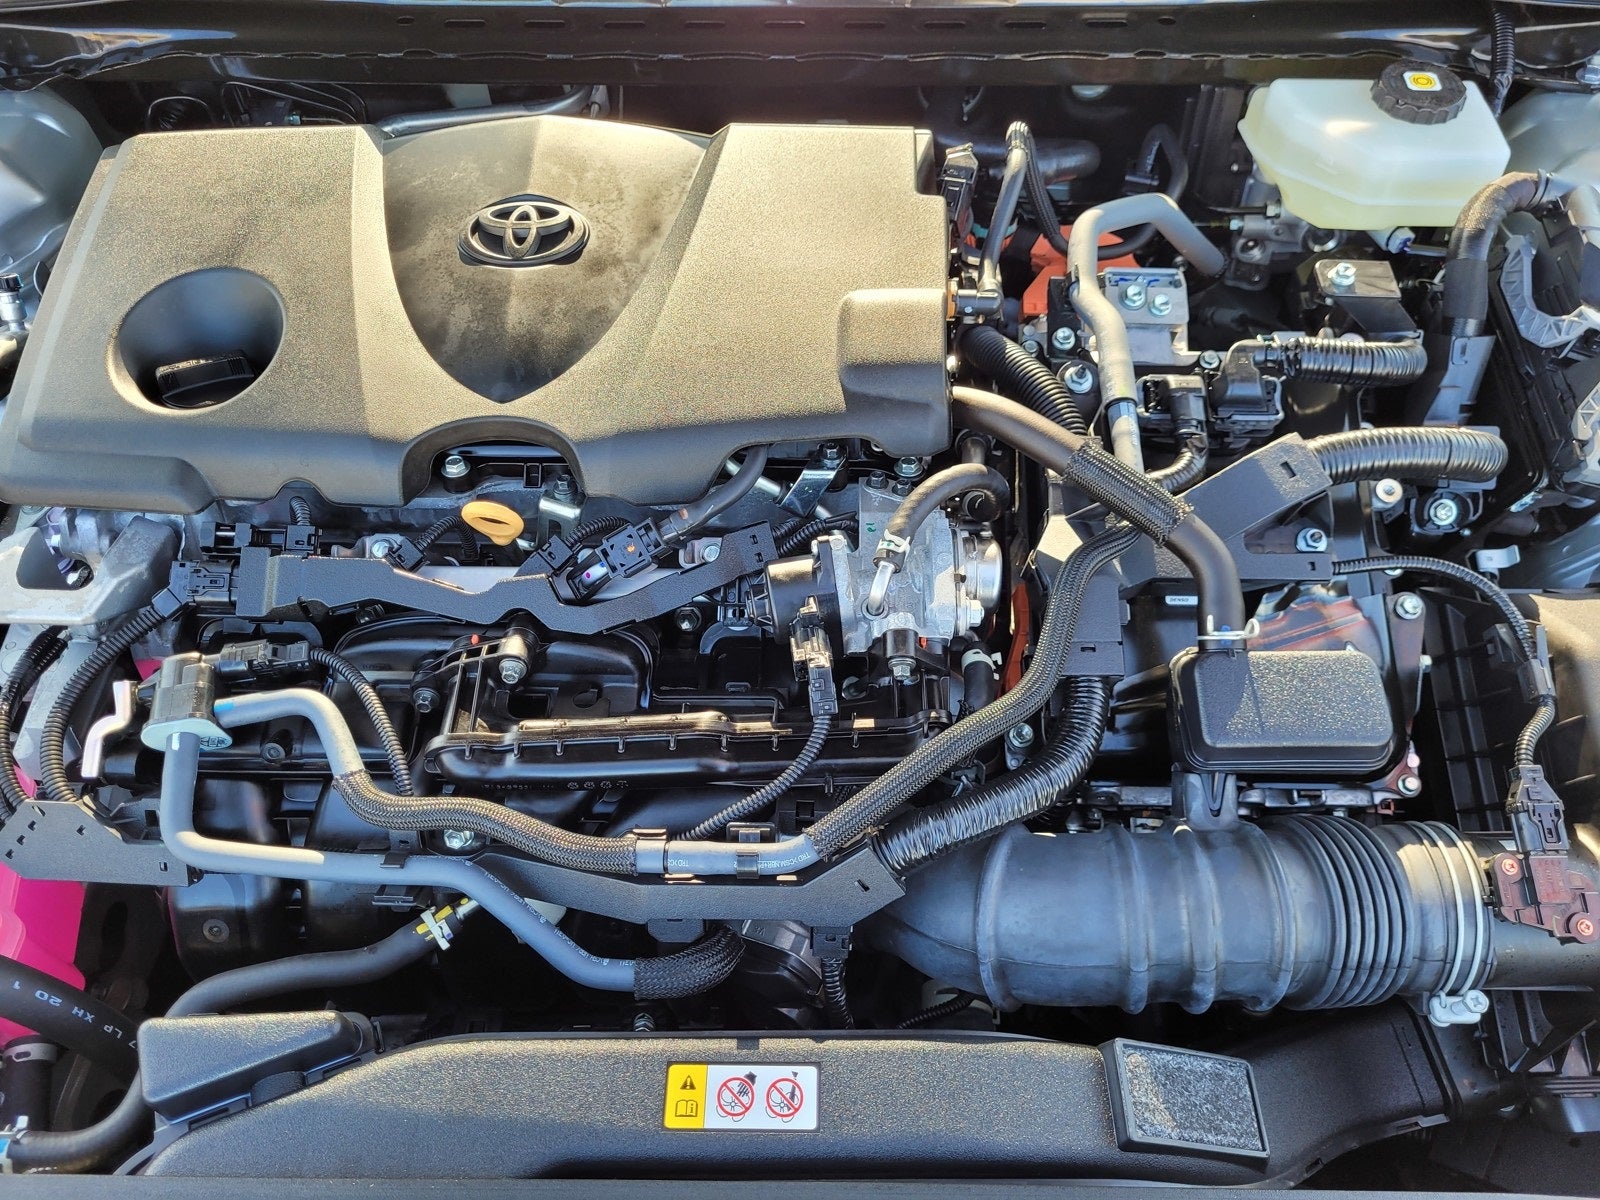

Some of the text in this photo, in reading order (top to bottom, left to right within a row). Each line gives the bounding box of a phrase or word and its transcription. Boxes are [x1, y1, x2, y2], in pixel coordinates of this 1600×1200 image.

[35, 990, 63, 1007] 20
[71, 1006, 95, 1024] XH
[103, 1024, 123, 1039] LP
